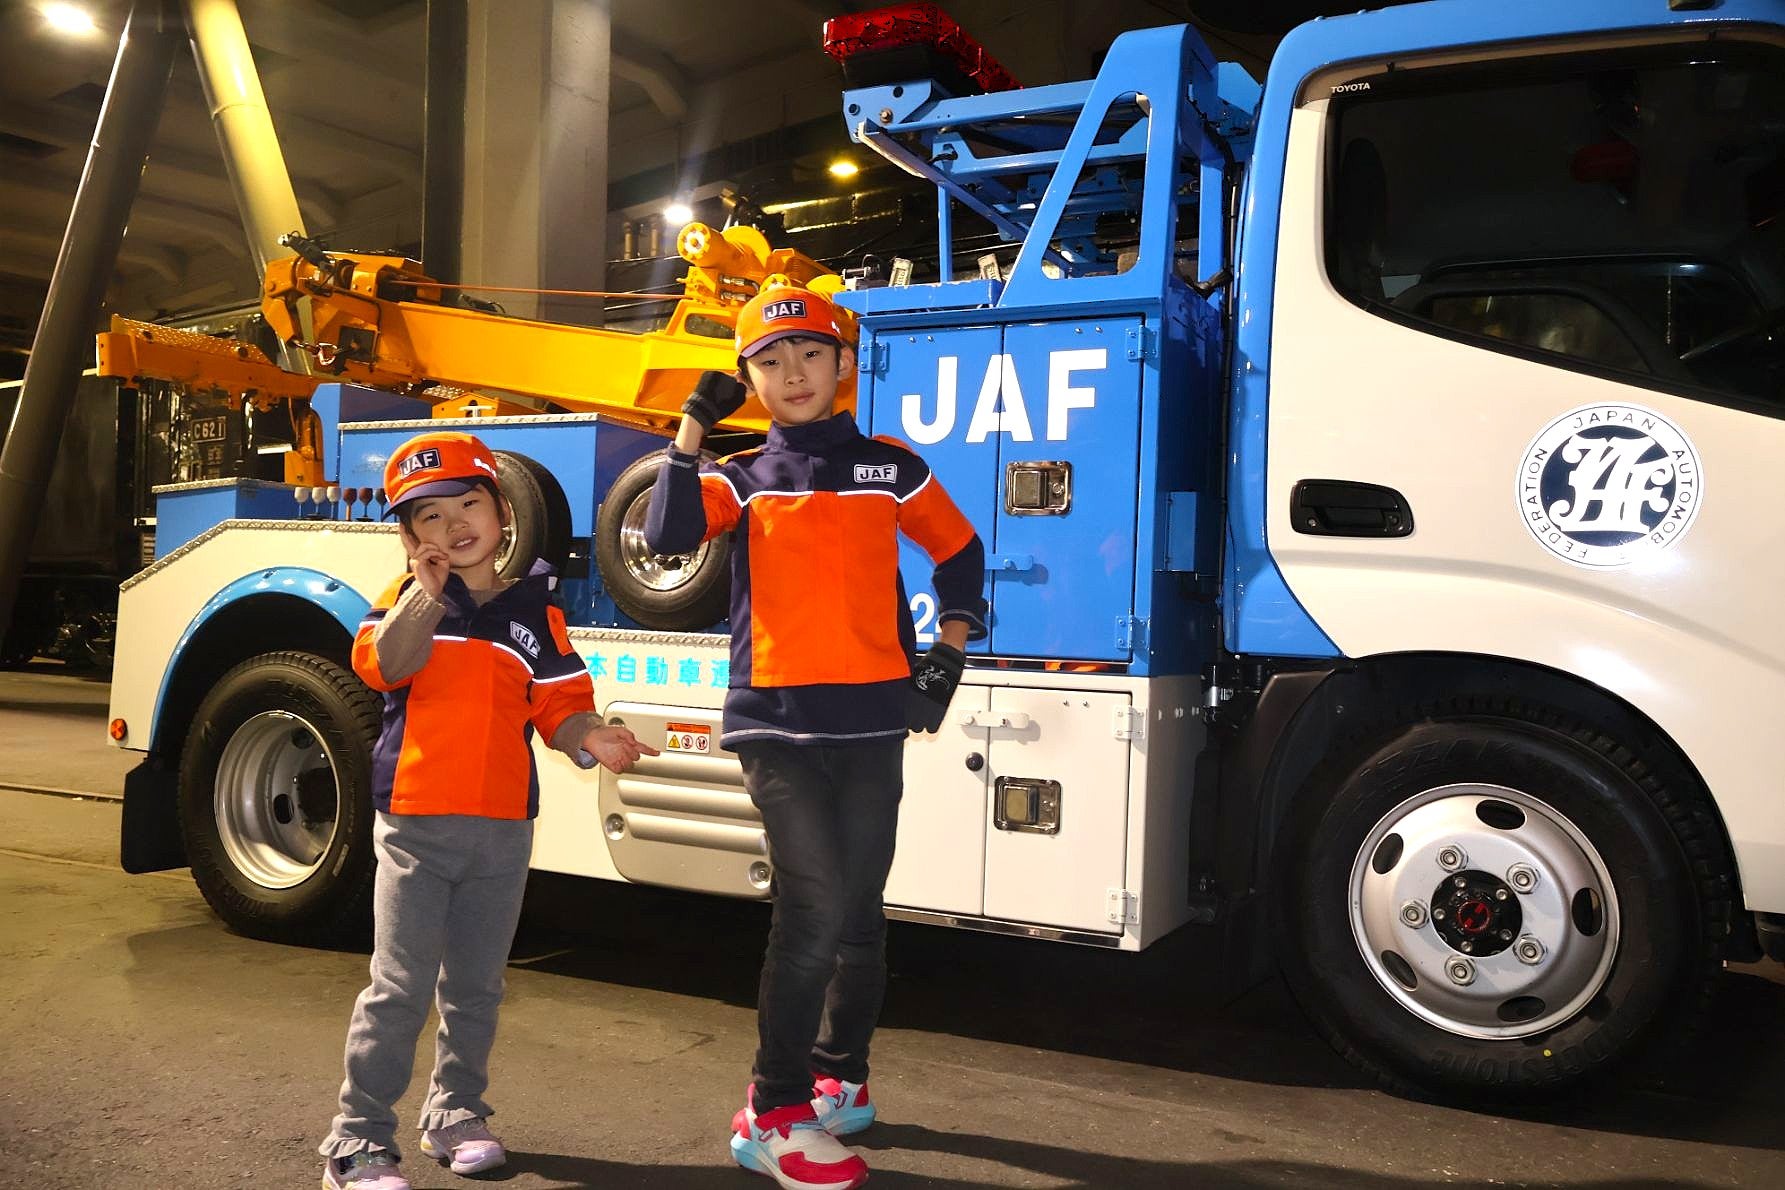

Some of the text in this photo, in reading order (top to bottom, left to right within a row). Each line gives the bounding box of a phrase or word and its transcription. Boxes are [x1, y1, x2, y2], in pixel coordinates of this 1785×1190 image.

[1330, 82, 1371, 93] TOYOTA
[767, 303, 800, 319] JAF
[901, 348, 1107, 445] JAF
[1573, 410, 1656, 431] JAPAN
[403, 453, 433, 475] JAF
[860, 467, 892, 480] JAF
[1525, 447, 1588, 559] FEDERATION
[910, 592, 942, 643] 2
[515, 629, 537, 650] JAF
